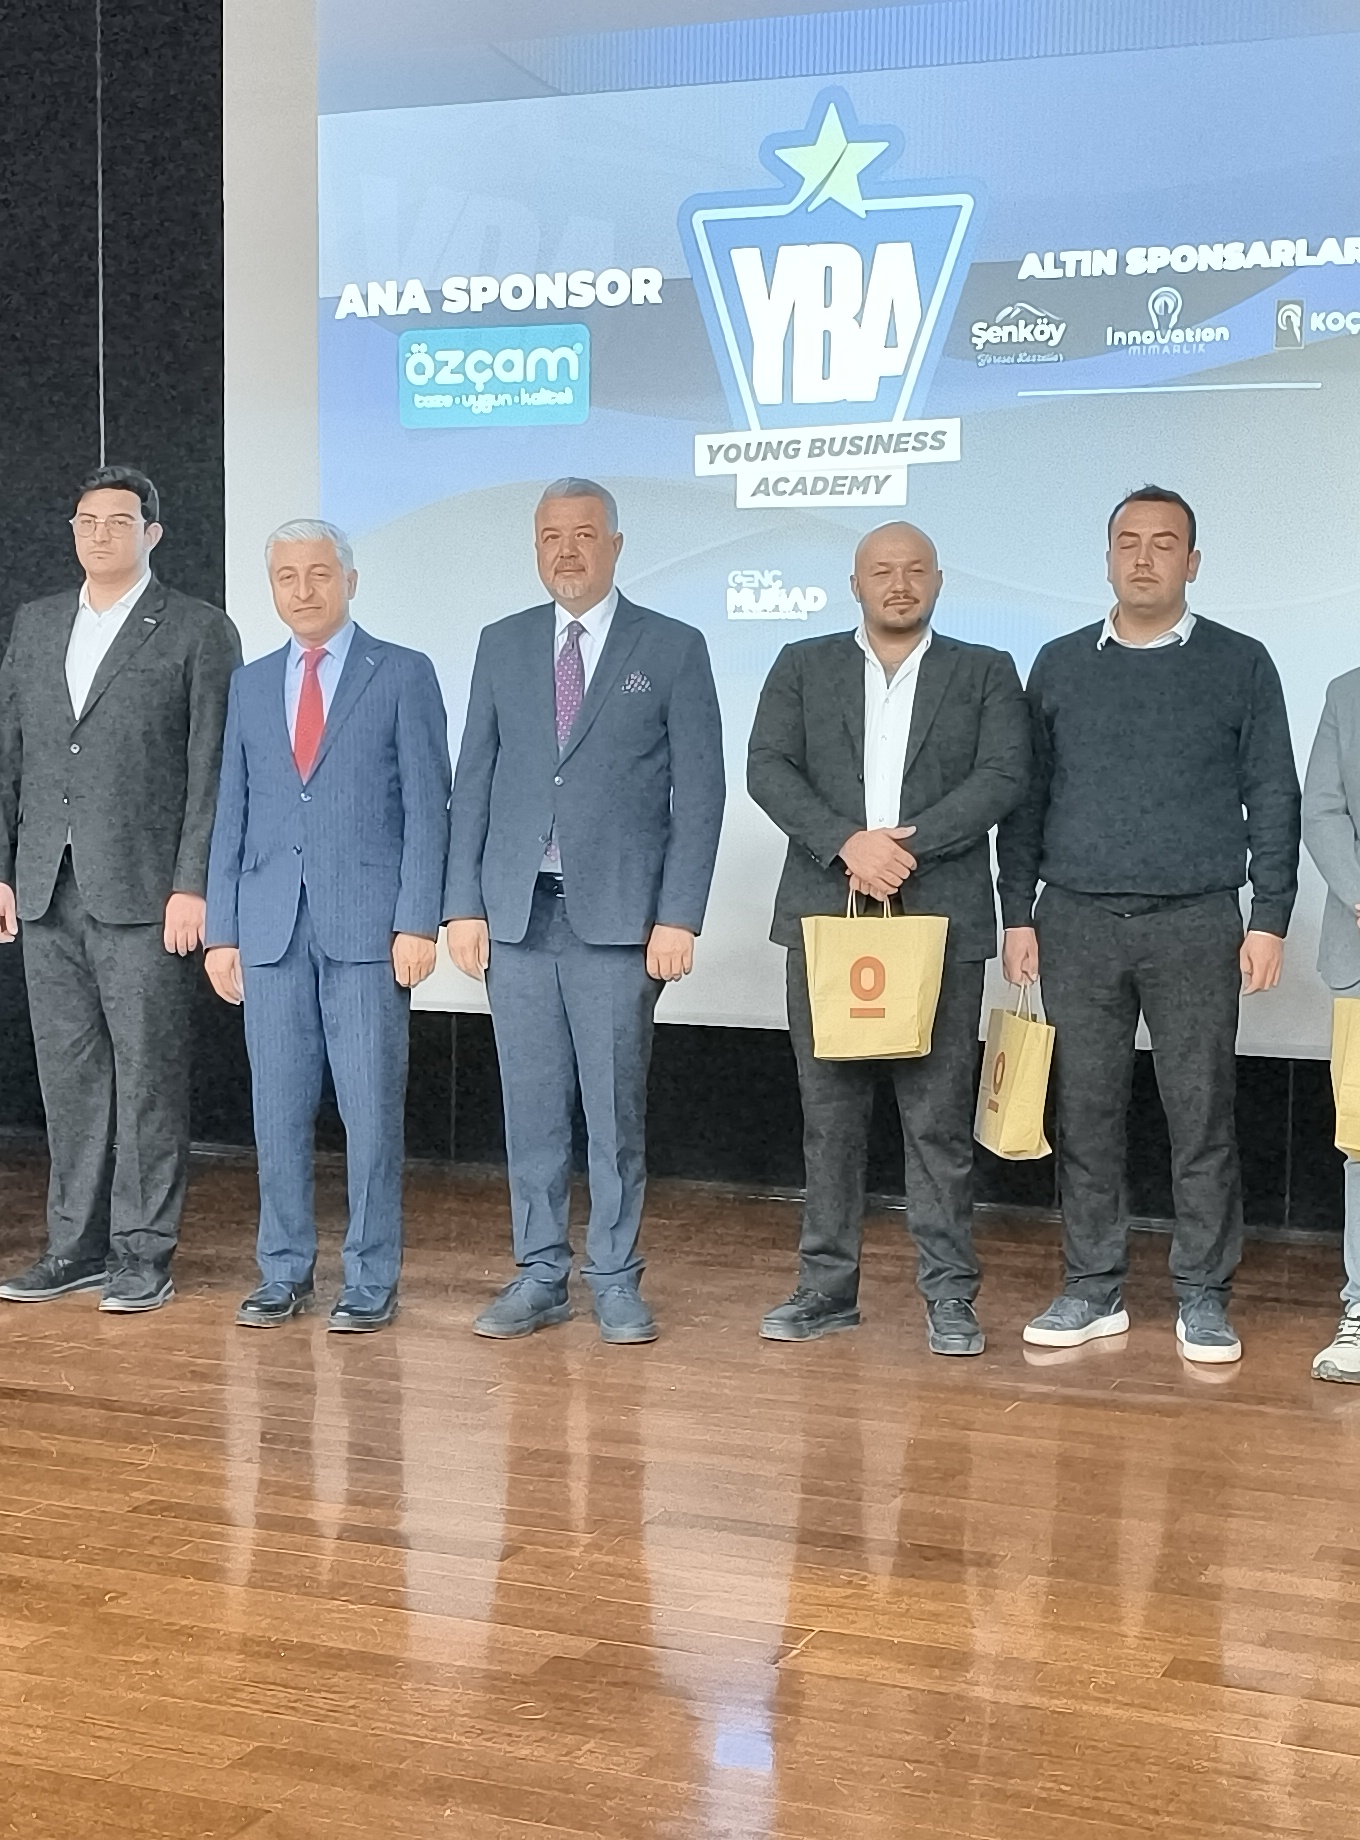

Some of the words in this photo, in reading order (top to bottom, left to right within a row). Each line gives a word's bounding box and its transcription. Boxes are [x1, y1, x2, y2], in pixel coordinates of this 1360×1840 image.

[1017, 249, 1117, 280] ALTIN
[335, 278, 432, 320] ANA
[440, 267, 664, 314] SPONSOR
[729, 241, 923, 406] YBA
[971, 317, 1067, 351] Şenköy
[1106, 326, 1230, 346] Innovation
[405, 343, 580, 392] özçam
[706, 439, 802, 465] YOUNG
[807, 430, 948, 459] BUSINESS
[750, 474, 893, 498] ACADEMY
